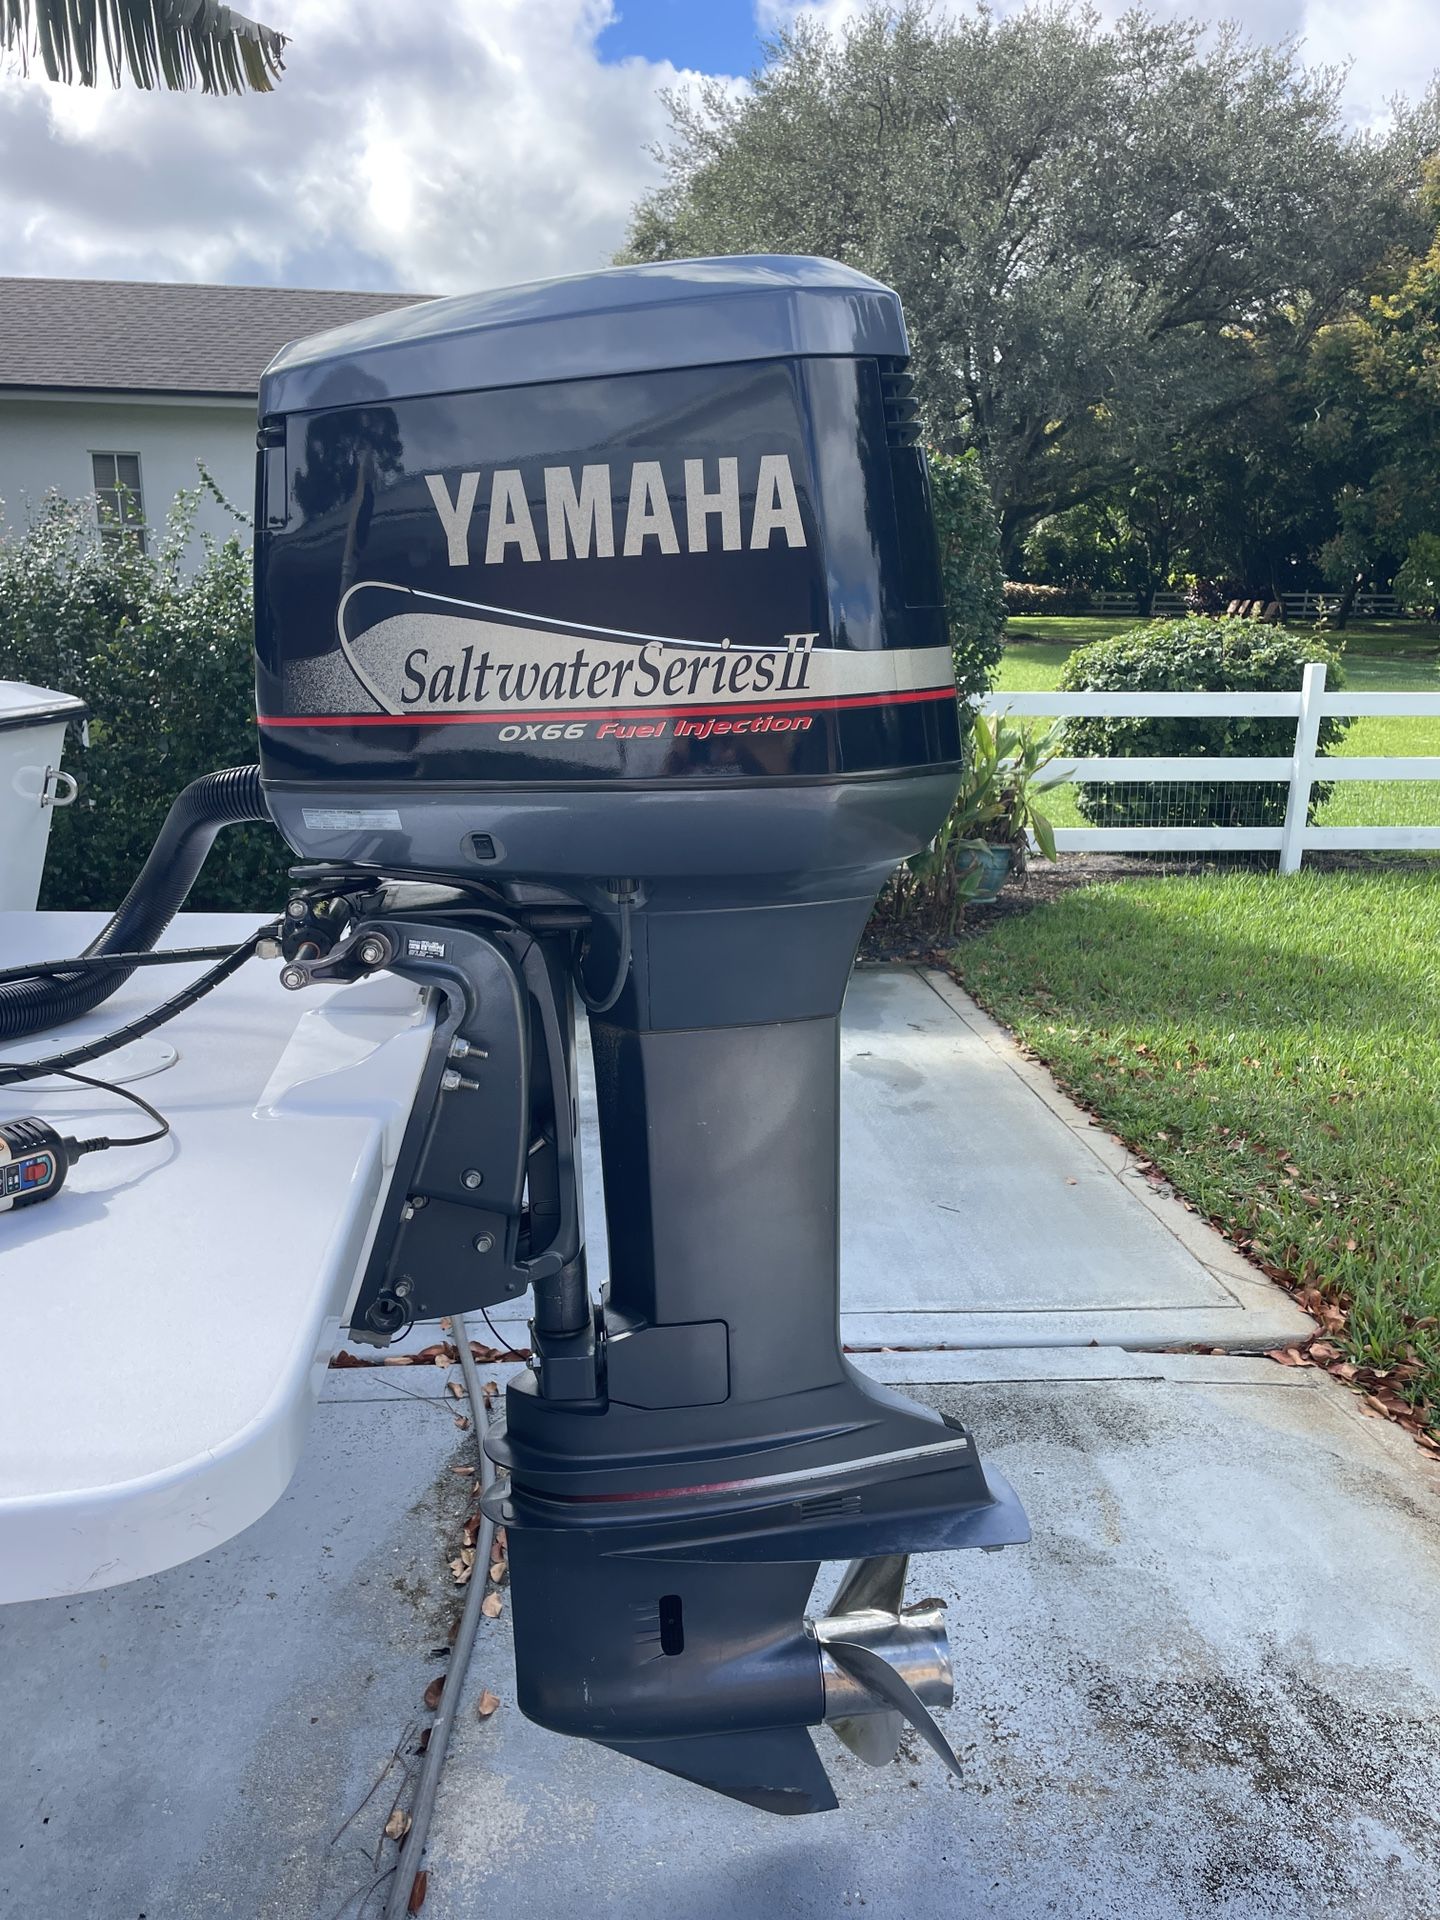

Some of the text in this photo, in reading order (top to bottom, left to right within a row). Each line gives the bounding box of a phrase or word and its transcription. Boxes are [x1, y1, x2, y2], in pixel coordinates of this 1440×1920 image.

[424, 454, 808, 567] YAMAHA
[497, 716, 813, 742] OX66 Fuel Injection
